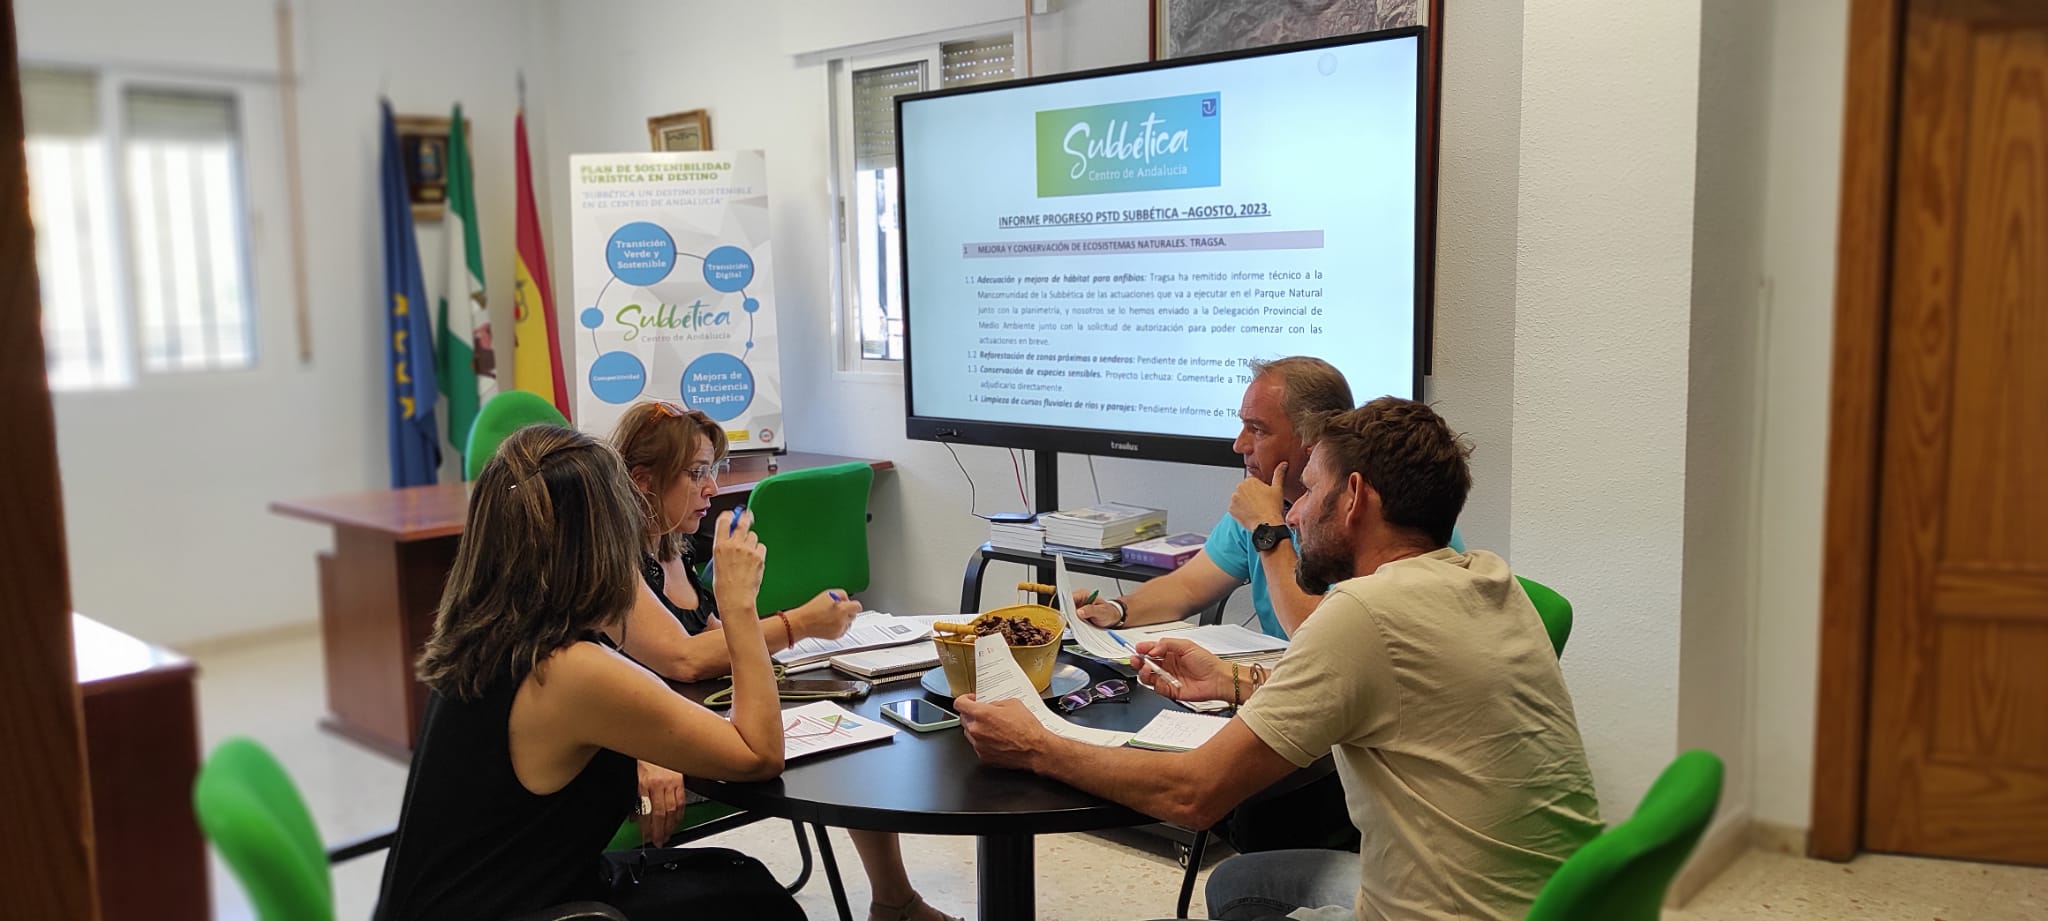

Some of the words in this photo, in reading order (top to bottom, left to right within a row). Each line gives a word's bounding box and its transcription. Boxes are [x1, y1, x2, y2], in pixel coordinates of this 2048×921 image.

[1063, 112, 1189, 179] Subbética
[580, 165, 612, 174] PLAN
[634, 162, 731, 172] SOSTENIBILIDAD
[1088, 170, 1120, 181] Centro
[1123, 168, 1134, 178] de
[1137, 164, 1187, 177] Andalucía
[648, 173, 663, 182] EN
[668, 172, 718, 181] DESTINO
[999, 215, 1040, 226] INFORME
[1043, 212, 1093, 224] PROGRESO
[1096, 211, 1120, 222] PSTD
[1123, 206, 1178, 221] SUBBÉTICA
[1240, 203, 1271, 215] 2023.
[616, 240, 666, 248] Transición
[978, 245, 1006, 253] MEJORA
[1014, 242, 1070, 252] CONSERVACIÓN
[1082, 241, 1135, 250] ECOSISTEMAS
[1138, 240, 1187, 249] NATURALES.
[1191, 238, 1226, 247] TRAGSA.
[624, 250, 651, 258] Verde
[618, 260, 666, 269] Sostenible
[977, 275, 1015, 284] Adecuación
[1018, 277, 1022, 285] y
[1024, 276, 1048, 285] mejora
[1093, 276, 1110, 284] para
[1113, 273, 1146, 283] anfibios:
[1151, 272, 1175, 283] Tragsa
[1178, 272, 1188, 281] ha
[1192, 272, 1227, 281] remitido
[1231, 272, 1264, 280] informe
[1269, 270, 1301, 280] técnico
[1315, 270, 1322, 279] la
[978, 291, 1028, 299] Mancomunidad
[1050, 290, 1083, 299] Subbética
[1098, 290, 1108, 298] las
[1157, 291, 1172, 300] que
[1194, 290, 1228, 300] ejecutar
[1244, 289, 1251, 297] el
[1255, 289, 1285, 299] Parque
[1289, 288, 1322, 297] Natural
[1072, 307, 1104, 315] nosotros
[1129, 307, 1154, 315] hemos
[1158, 307, 1189, 315] enviado
[1202, 307, 1208, 315] la
[1212, 306, 1259, 317] Delegación
[1264, 306, 1307, 315] Provincial
[1311, 306, 1322, 315] de
[616, 300, 731, 341] Subbética
[1003, 322, 1035, 330] Ambiente
[1038, 323, 1057, 332] junto
[1087, 323, 1118, 331] solicitud
[1122, 323, 1131, 331] de
[1136, 323, 1183, 332] autorización
[1188, 326, 1206, 334] para
[1211, 324, 1235, 334] poder
[1311, 324, 1322, 334] las
[641, 334, 670, 342] Centro
[980, 351, 1024, 360] Reforestación
[1058, 354, 1090, 363] próximas
[1100, 355, 1135, 363] senderos:
[1137, 356, 1175, 365] Pendiente
[1178, 357, 1188, 365] de
[1190, 357, 1222, 366] informe
[1225, 357, 1235, 366] de
[693, 373, 727, 383] Mejora
[730, 372, 742, 380] de
[980, 366, 1023, 374] Conservación
[1037, 368, 1065, 377] especies
[1068, 370, 1102, 378] sensibles.
[1105, 370, 1138, 379] Proyecto
[1140, 372, 1171, 381] Lechuza:
[1177, 373, 1224, 383] Comentarle
[688, 384, 696, 392] la
[700, 383, 748, 391] Eficiencia
[693, 395, 744, 404] Energética
[981, 395, 1009, 404] Limpieza
[1021, 398, 1042, 406] cursos
[1043, 398, 1072, 408] fluviales
[1106, 403, 1137, 412] parajes:
[1138, 404, 1177, 414] Pendiente
[1179, 406, 1211, 416] informe
[1213, 408, 1223, 417] de
